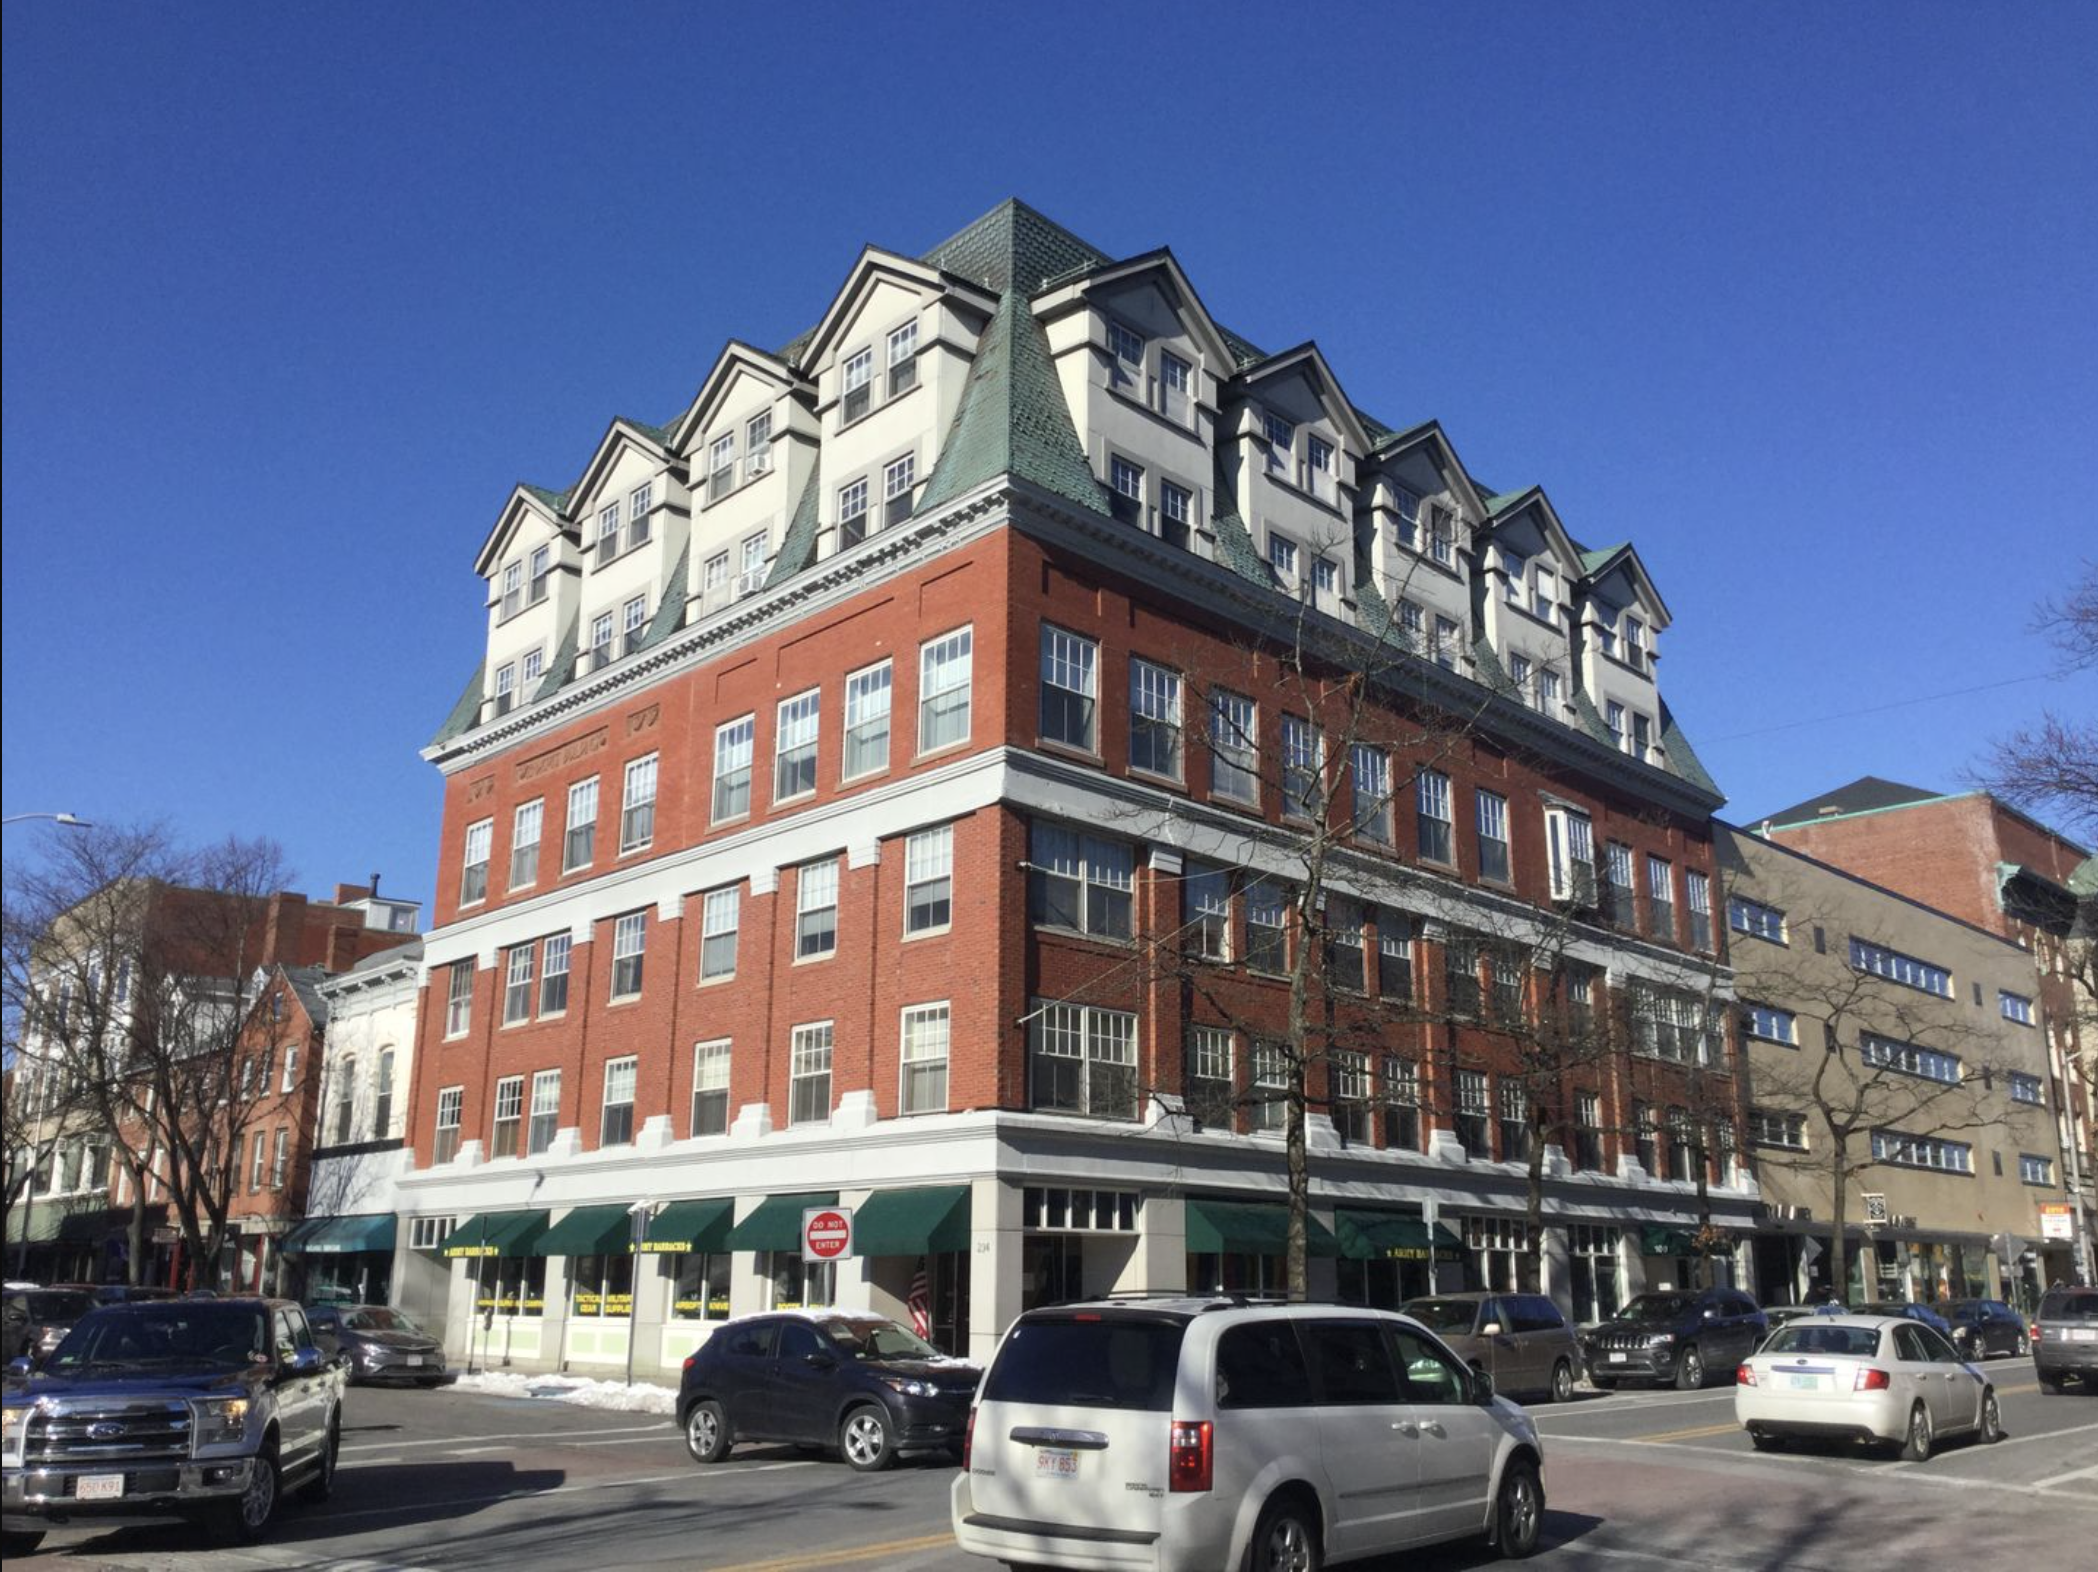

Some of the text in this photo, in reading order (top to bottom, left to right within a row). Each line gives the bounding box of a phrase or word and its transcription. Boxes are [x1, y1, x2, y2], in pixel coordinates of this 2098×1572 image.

[813, 1220, 844, 1229] DO NOT
[815, 1240, 840, 1250] ENTER
[1394, 1248, 1415, 1259] ARMY
